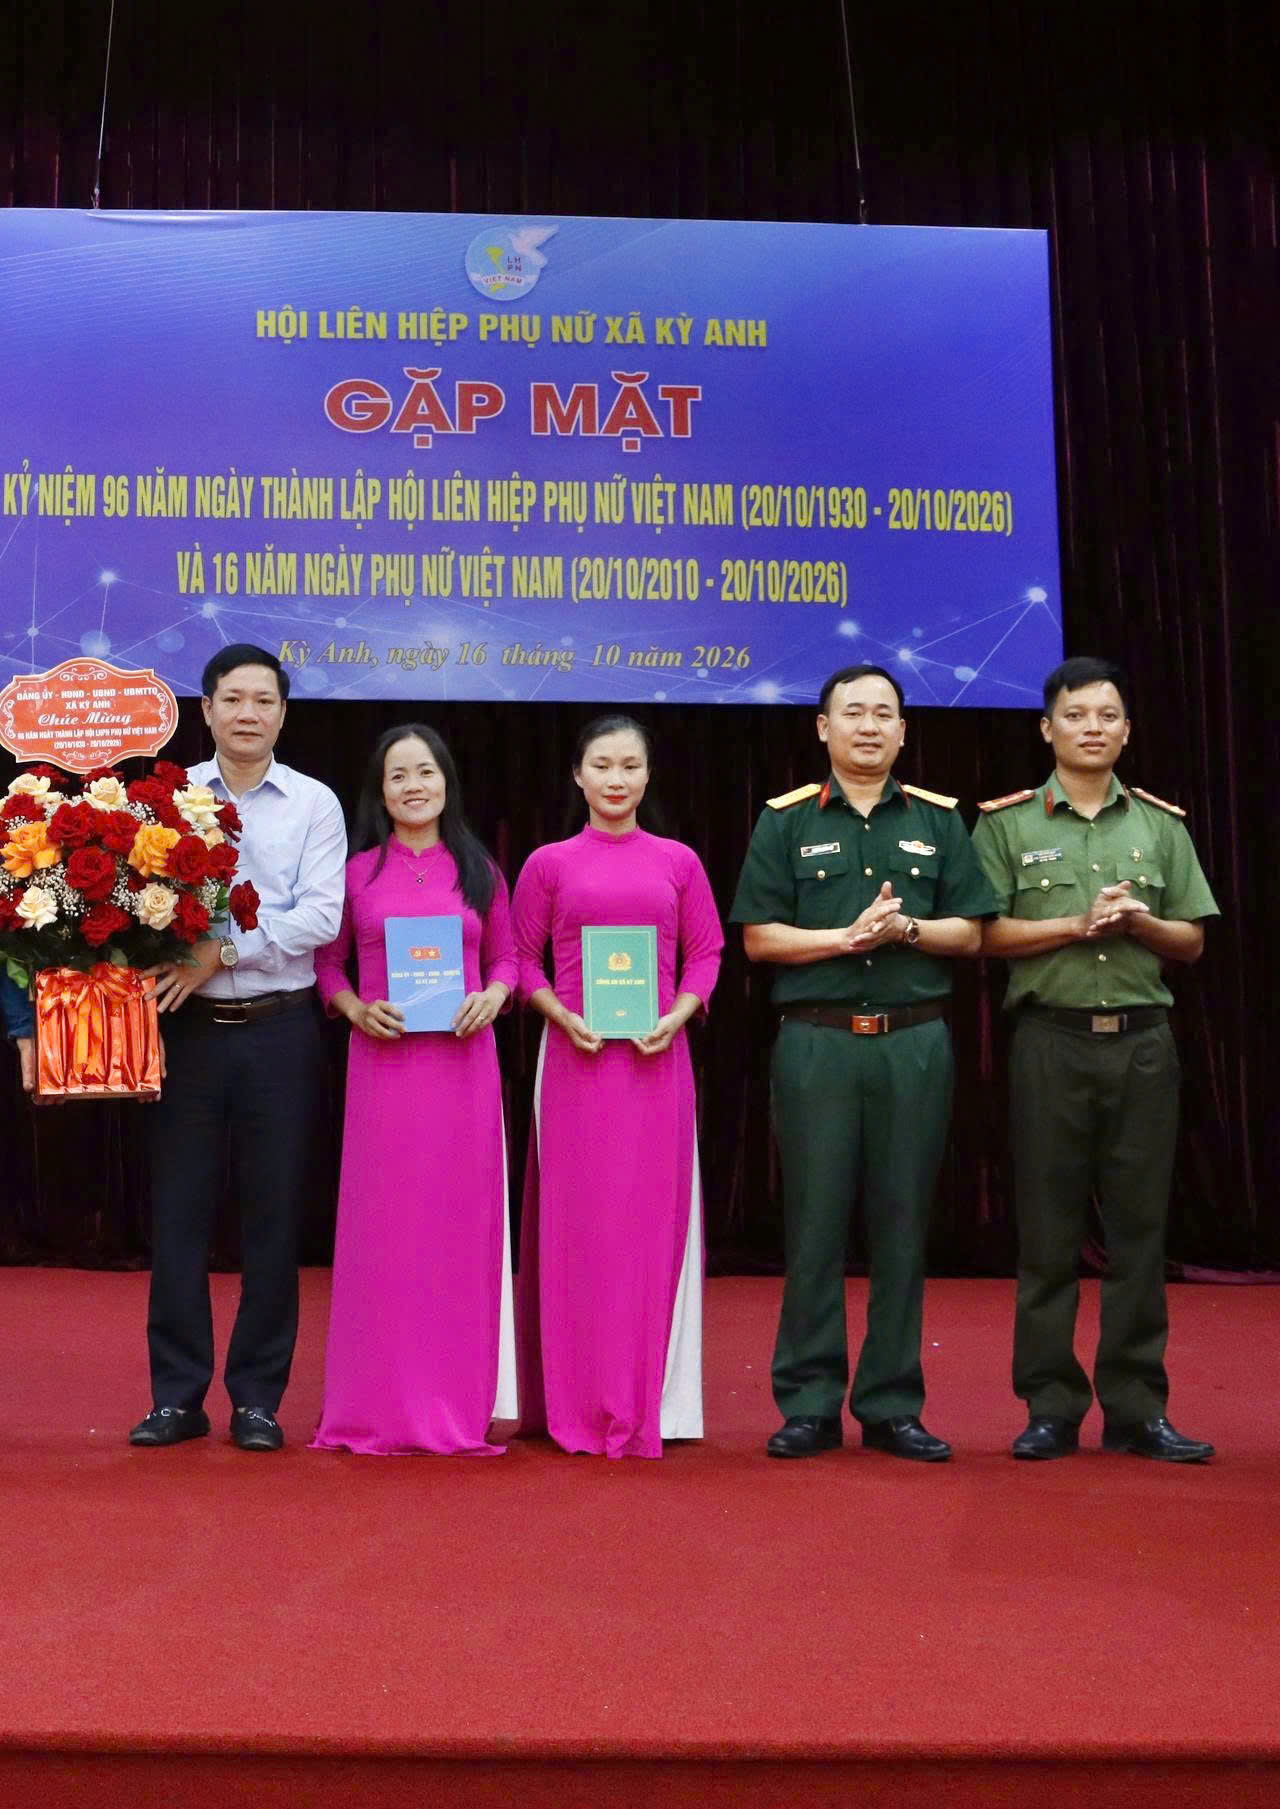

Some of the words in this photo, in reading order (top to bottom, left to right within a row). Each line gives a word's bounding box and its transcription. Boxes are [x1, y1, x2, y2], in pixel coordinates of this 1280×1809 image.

[256, 304, 308, 344] HỘI
[319, 305, 387, 340] LIÊN
[398, 306, 468, 347] HIỆP
[479, 313, 541, 348] PHỤ
[551, 310, 597, 343] NỮ
[604, 311, 646, 344] XÃ
[655, 312, 693, 345] KỲ
[704, 319, 767, 347] ANH
[323, 367, 506, 450] GẶP
[530, 370, 702, 453] MẶT
[3, 458, 32, 516] KỶ
[38, 465, 96, 526] NIỆM
[103, 475, 129, 517] 96
[136, 466, 188, 518] NĂM
[195, 467, 255, 519] NGÀY
[261, 467, 333, 520] THÀNH
[340, 468, 382, 530] LẬP
[388, 469, 425, 530] HỘI
[432, 470, 481, 522] LIÊN
[487, 471, 537, 532] HIỆP
[543, 480, 588, 533] PHỤ
[594, 473, 627, 524] NỮ
[631, 473, 676, 534] VIỆT
[683, 483, 734, 525] NAM
[741, 484, 868, 530] (20/10/1930
[888, 489, 1013, 536] 20/10/2026)
[176, 542, 205, 594] VÀ
[213, 552, 239, 595] 16
[245, 543, 297, 595] NĂM
[304, 544, 363, 596] NGÀY
[371, 554, 415, 606] PHỤ
[422, 546, 455, 597] NỮ
[459, 546, 505, 607] VIỆT
[512, 556, 563, 599] NAM
[571, 557, 699, 602] (20/10/2010
[721, 561, 848, 608] 20/10/2026)
[278, 640, 311, 668] Kỳ
[317, 640, 379, 668] Anh,
[387, 641, 449, 671] ngày
[455, 641, 488, 666] 16
[501, 643, 576, 673] tháng
[592, 643, 621, 667] 10
[627, 646, 683, 668] năm
[691, 646, 751, 669] 2026
[38, 712, 79, 727] Chúc
[82, 711, 132, 726] Mừng
